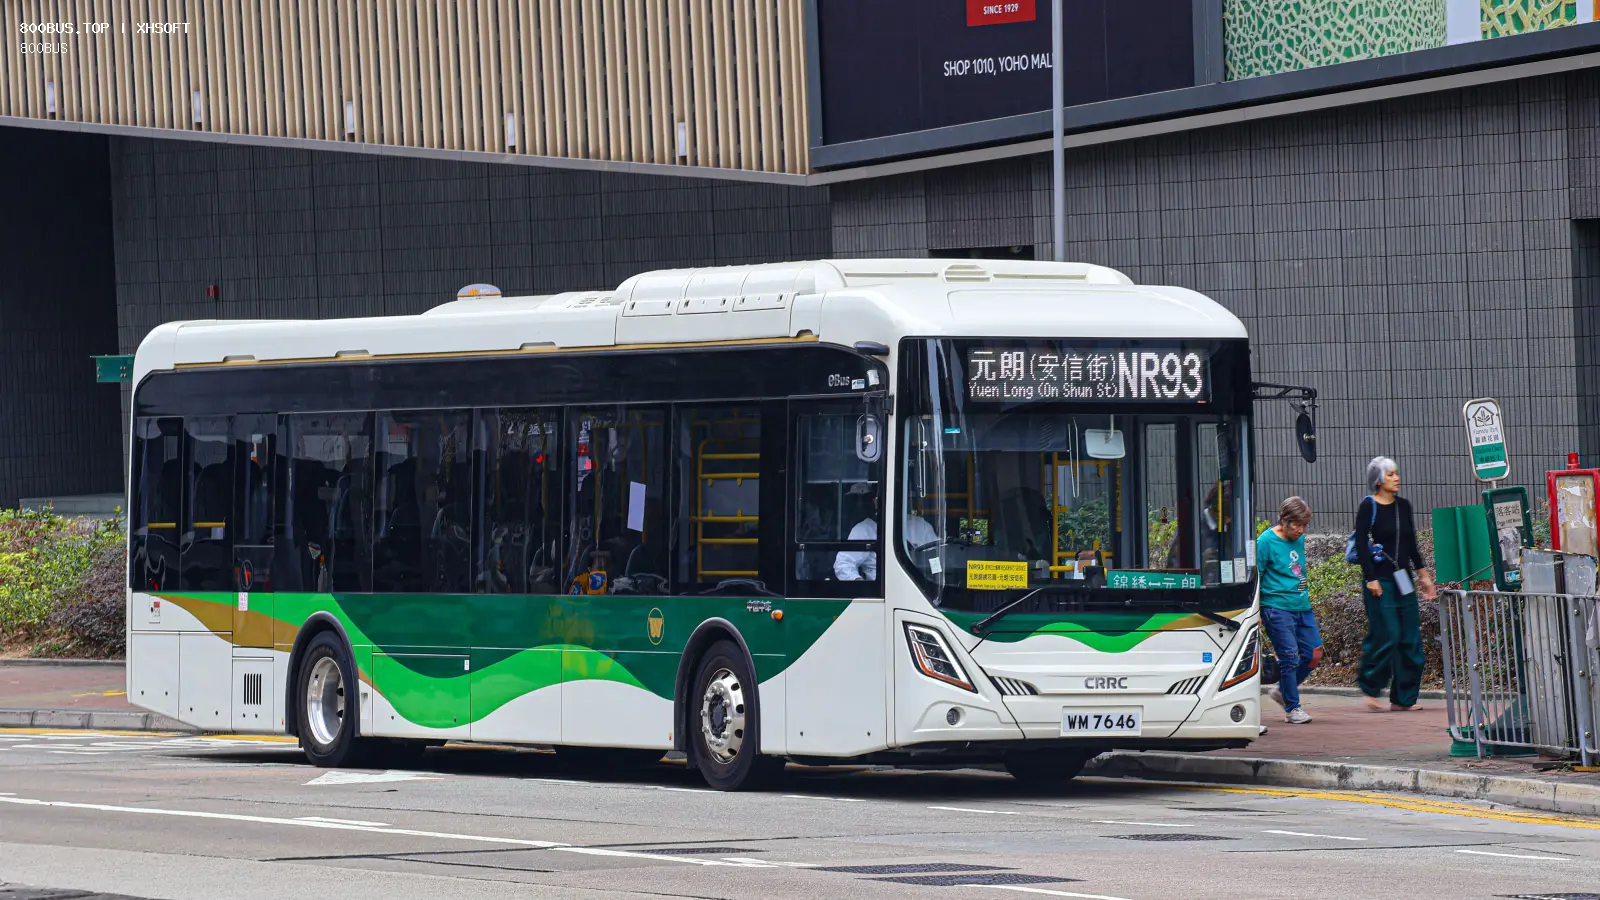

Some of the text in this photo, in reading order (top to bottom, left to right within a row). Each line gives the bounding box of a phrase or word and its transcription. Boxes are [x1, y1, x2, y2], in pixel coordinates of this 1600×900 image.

[984, 4, 1019, 15] SINCE 1929
[943, 52, 1054, 77] SHOP 1010, YOHO MAL
[1118, 352, 1203, 398] NR93
[969, 382, 1118, 399] Yuen Long (On Shun St)
[1495, 504, 1521, 517] 落客站
[1084, 677, 1128, 689] CRRC
[1067, 714, 1136, 729] WM 7646
